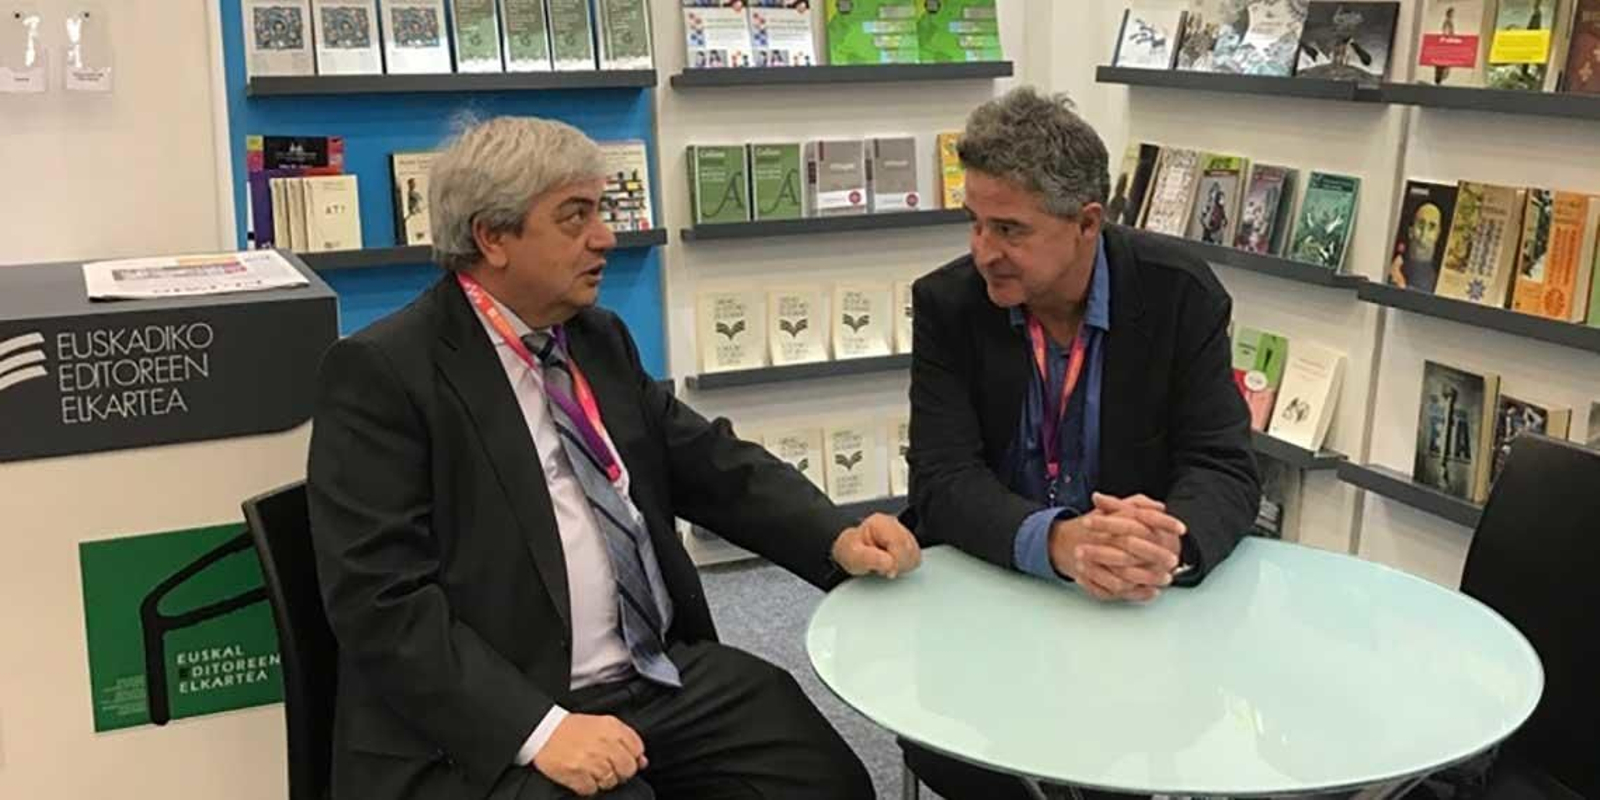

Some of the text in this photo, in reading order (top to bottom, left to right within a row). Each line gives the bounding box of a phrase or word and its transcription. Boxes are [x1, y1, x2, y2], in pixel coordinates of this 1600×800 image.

[57, 322, 213, 360] EUSKADIKO
[59, 353, 209, 391] EDITOREEN
[62, 388, 188, 424] ELKARTEA
[176, 644, 245, 665] EUSKAL
[179, 670, 268, 694] ELKARTEA
